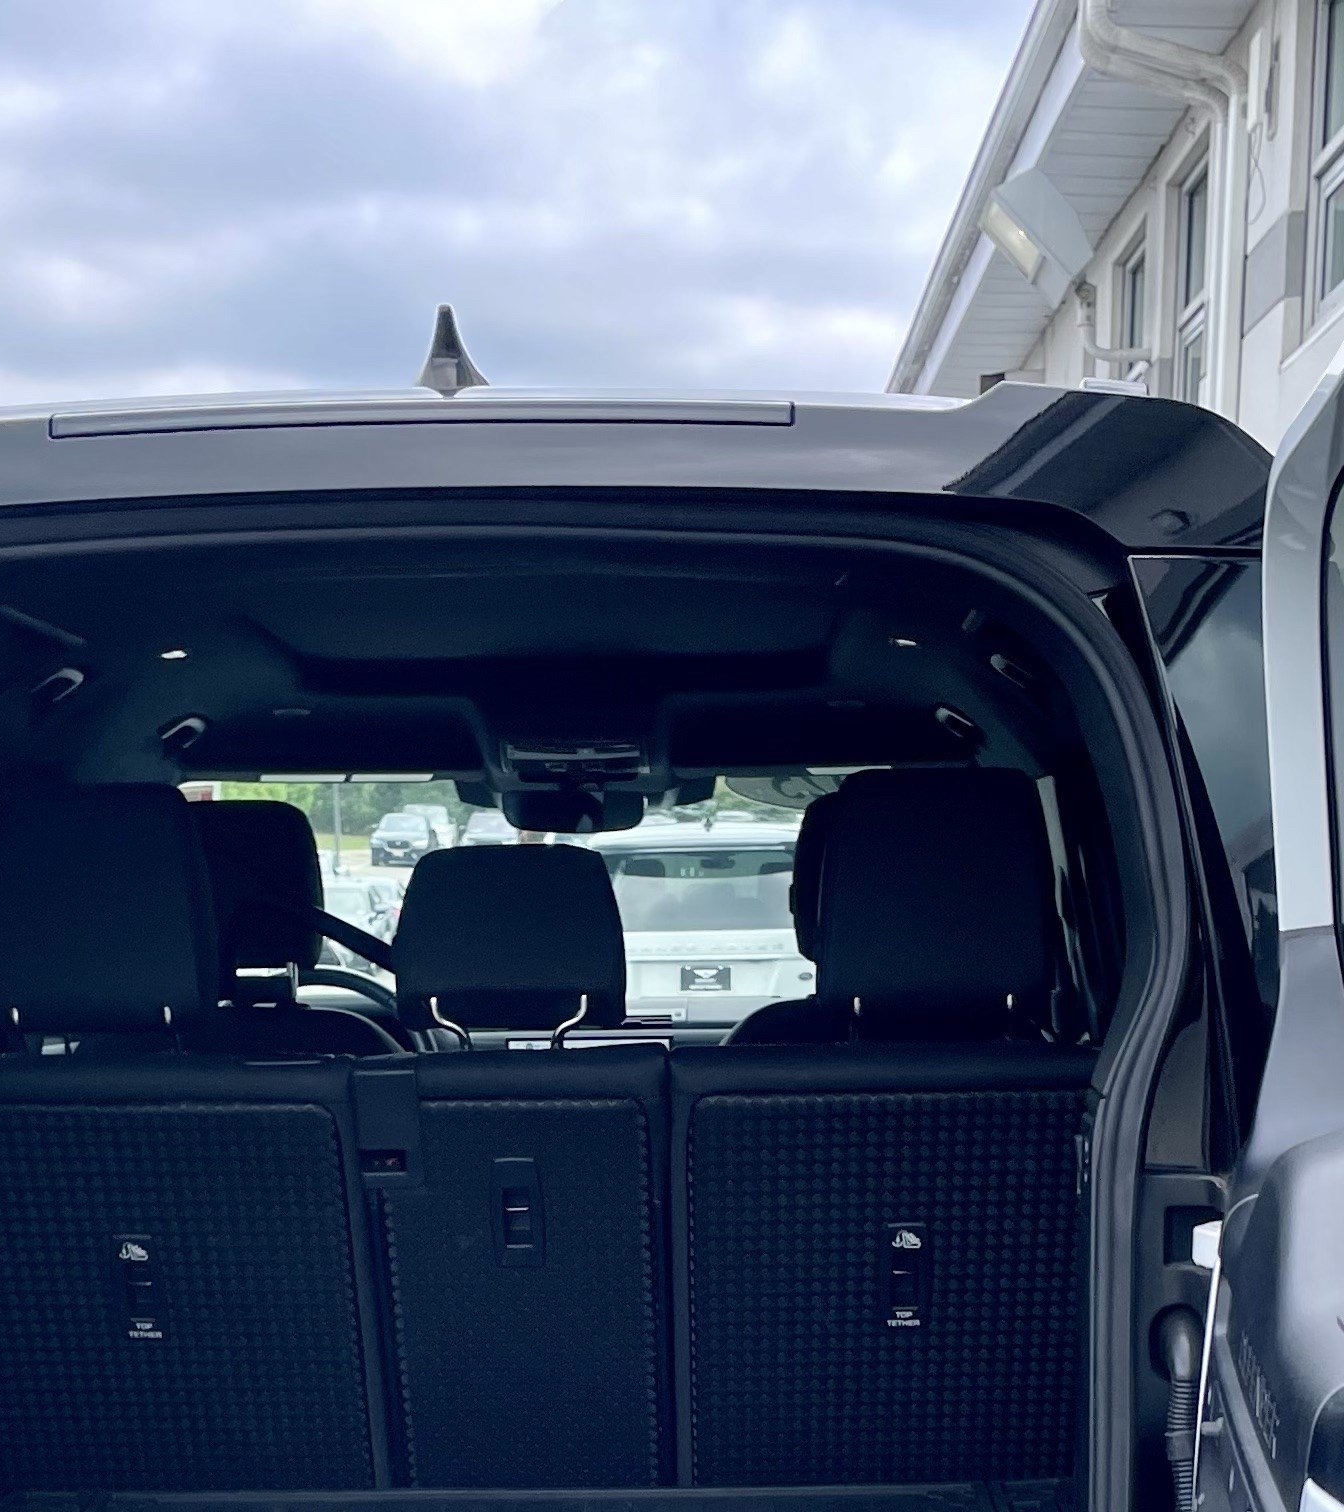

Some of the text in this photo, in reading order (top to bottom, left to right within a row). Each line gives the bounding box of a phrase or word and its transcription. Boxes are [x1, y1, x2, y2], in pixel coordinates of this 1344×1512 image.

[135, 1322, 153, 1330] TOP
[887, 1319, 920, 1327] TETHER
[128, 1330, 163, 1338] TETHER
